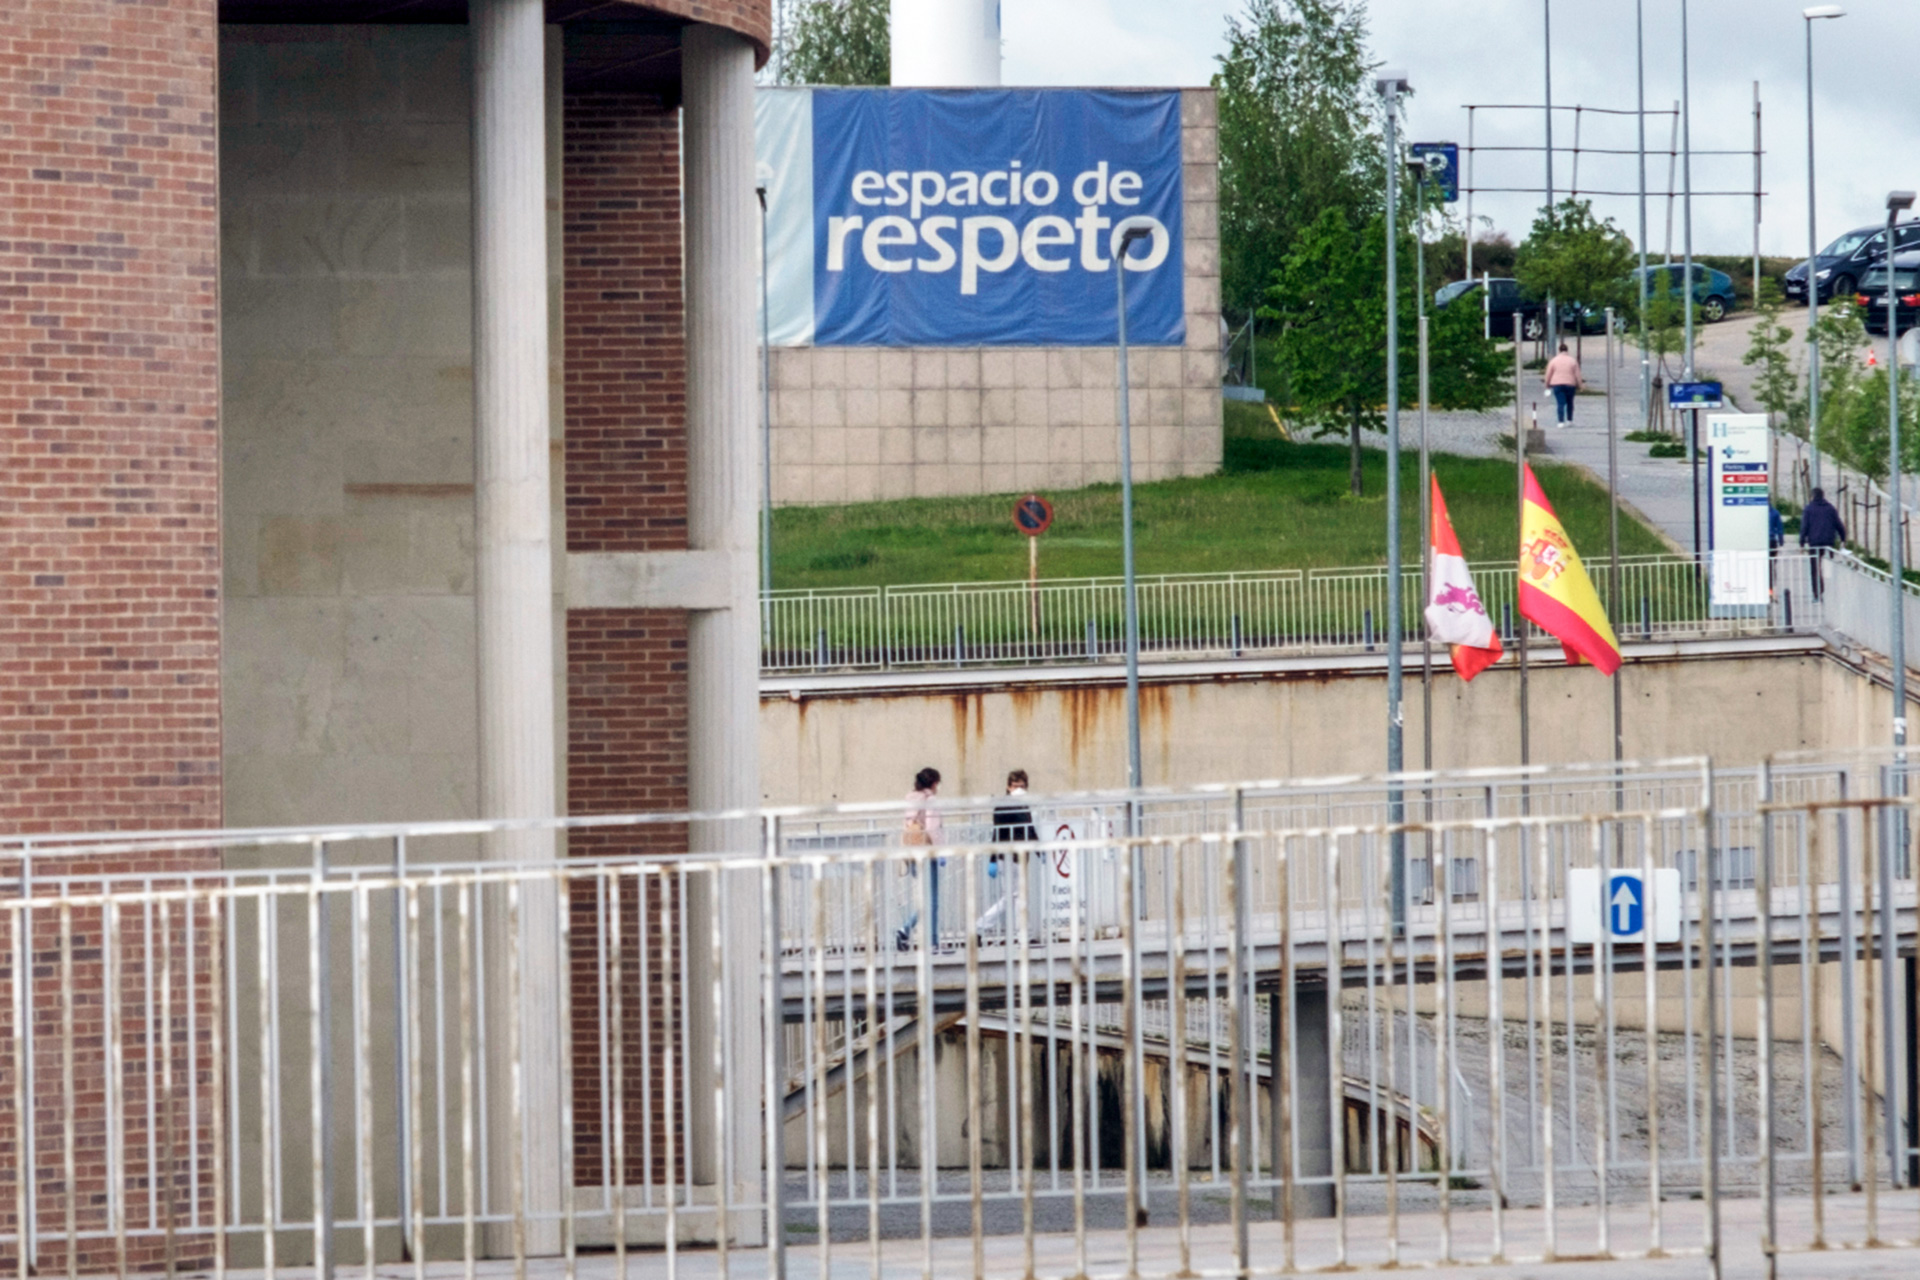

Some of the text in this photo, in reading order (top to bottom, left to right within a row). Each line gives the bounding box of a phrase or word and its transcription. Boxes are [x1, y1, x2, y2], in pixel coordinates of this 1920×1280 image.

[851, 160, 1143, 219] espacio de
[826, 206, 1170, 295] respeto
